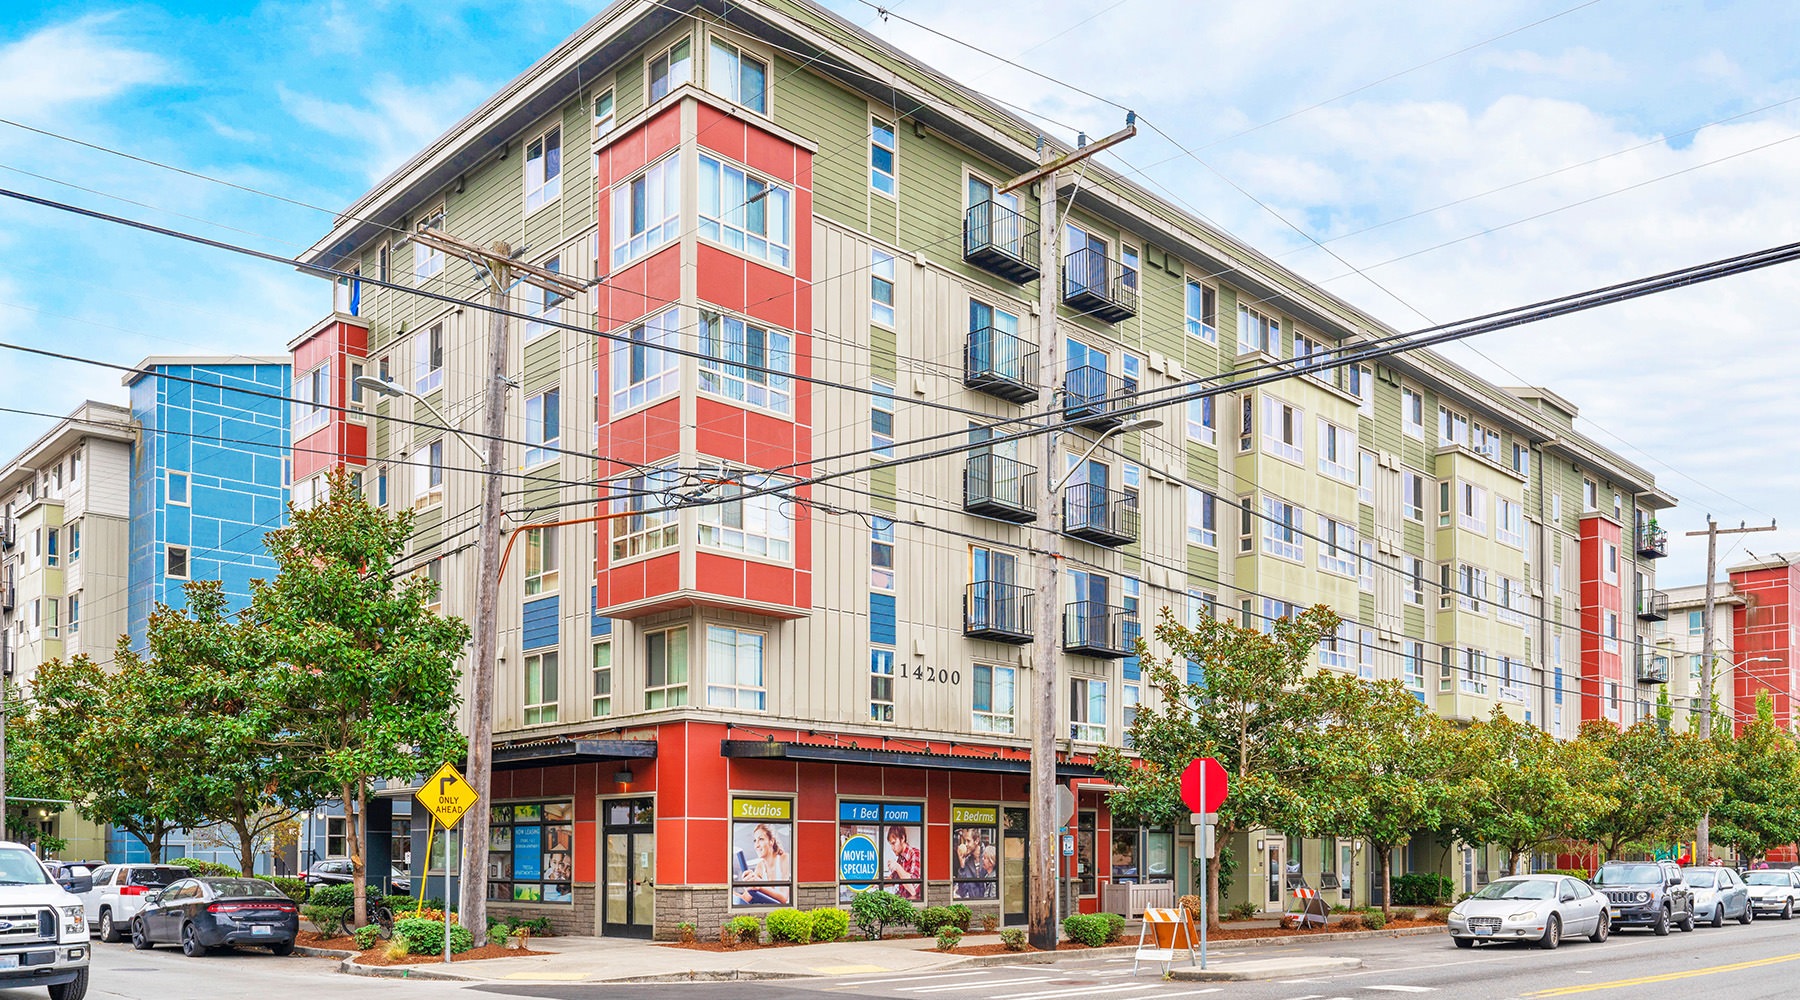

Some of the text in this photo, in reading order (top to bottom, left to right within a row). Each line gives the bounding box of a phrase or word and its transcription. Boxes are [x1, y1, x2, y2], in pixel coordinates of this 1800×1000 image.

[900, 663, 961, 686] 14200
[438, 796, 459, 805] ONLY
[435, 805, 463, 814] AHEAD
[741, 803, 782, 817] Studios
[852, 807, 857, 819] 1
[955, 810, 994, 822] 2 Bedrms
[843, 850, 875, 861] MOVE-IN
[843, 863, 875, 875] SPECIALS
